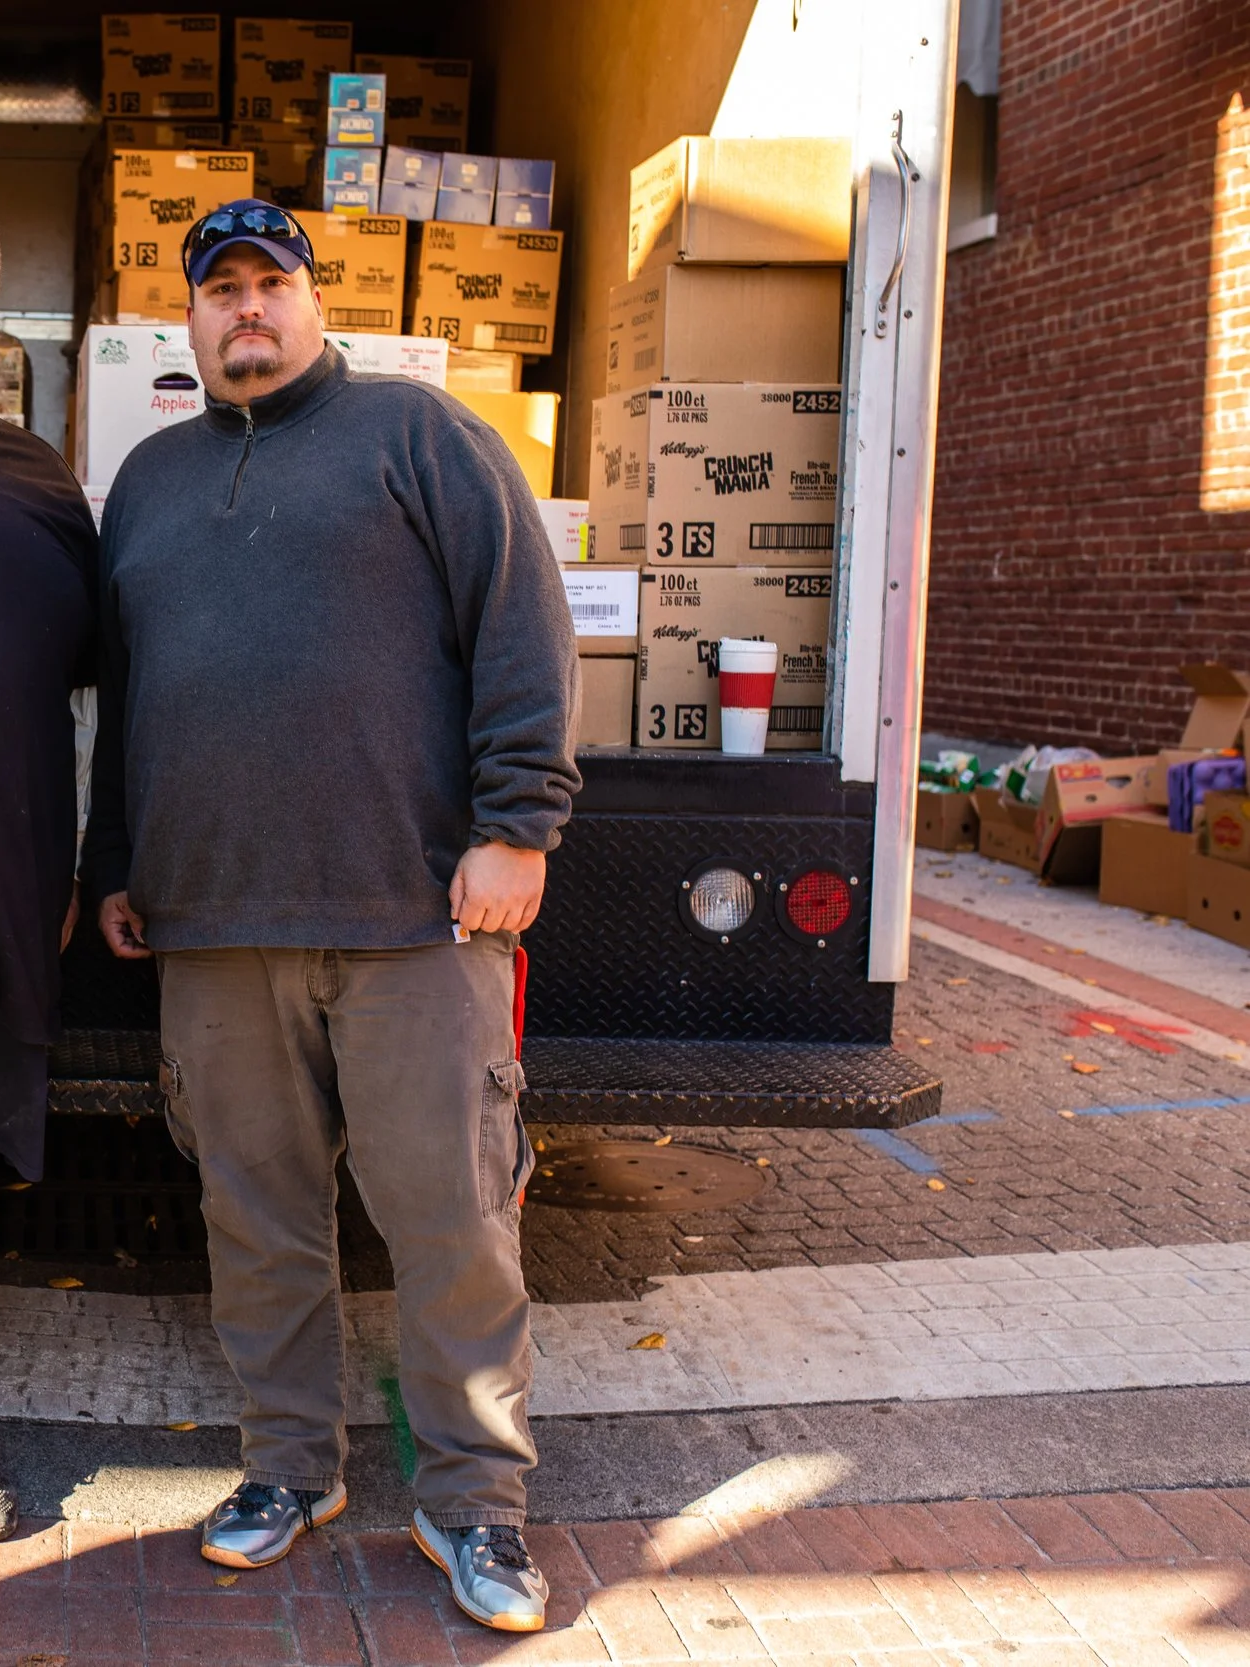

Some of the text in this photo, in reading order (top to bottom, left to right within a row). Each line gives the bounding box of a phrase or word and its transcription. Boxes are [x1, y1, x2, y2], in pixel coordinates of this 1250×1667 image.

[209, 158, 246, 169] 24520
[150, 196, 195, 215] CRUNCH
[157, 209, 193, 224] MANIA
[361, 220, 399, 233] 24520
[519, 236, 557, 250] 24520
[119, 243, 156, 266] 3 FS
[314, 260, 344, 272] UNCH
[457, 274, 502, 289] CRUNCH
[463, 285, 499, 300] MANIA
[421, 316, 459, 341] 3 FS
[151, 395, 196, 414] Apples
[761, 394, 791, 403] 38000
[795, 395, 841, 411] 2452
[667, 413, 708, 423] 1.76 OZ PKGS
[660, 441, 706, 458] Kellogg's
[704, 452, 773, 480] CRUNCH
[714, 472, 770, 495] MANIA
[790, 471, 837, 485] French Toa
[657, 522, 713, 557] 3 FS
[754, 577, 783, 587] 38000
[788, 579, 831, 594] 2452
[660, 597, 701, 606] 1.76 OZ PKGS
[653, 625, 699, 641] Kellogg's
[783, 654, 812, 668] French
[649, 704, 704, 740] 3 FS
